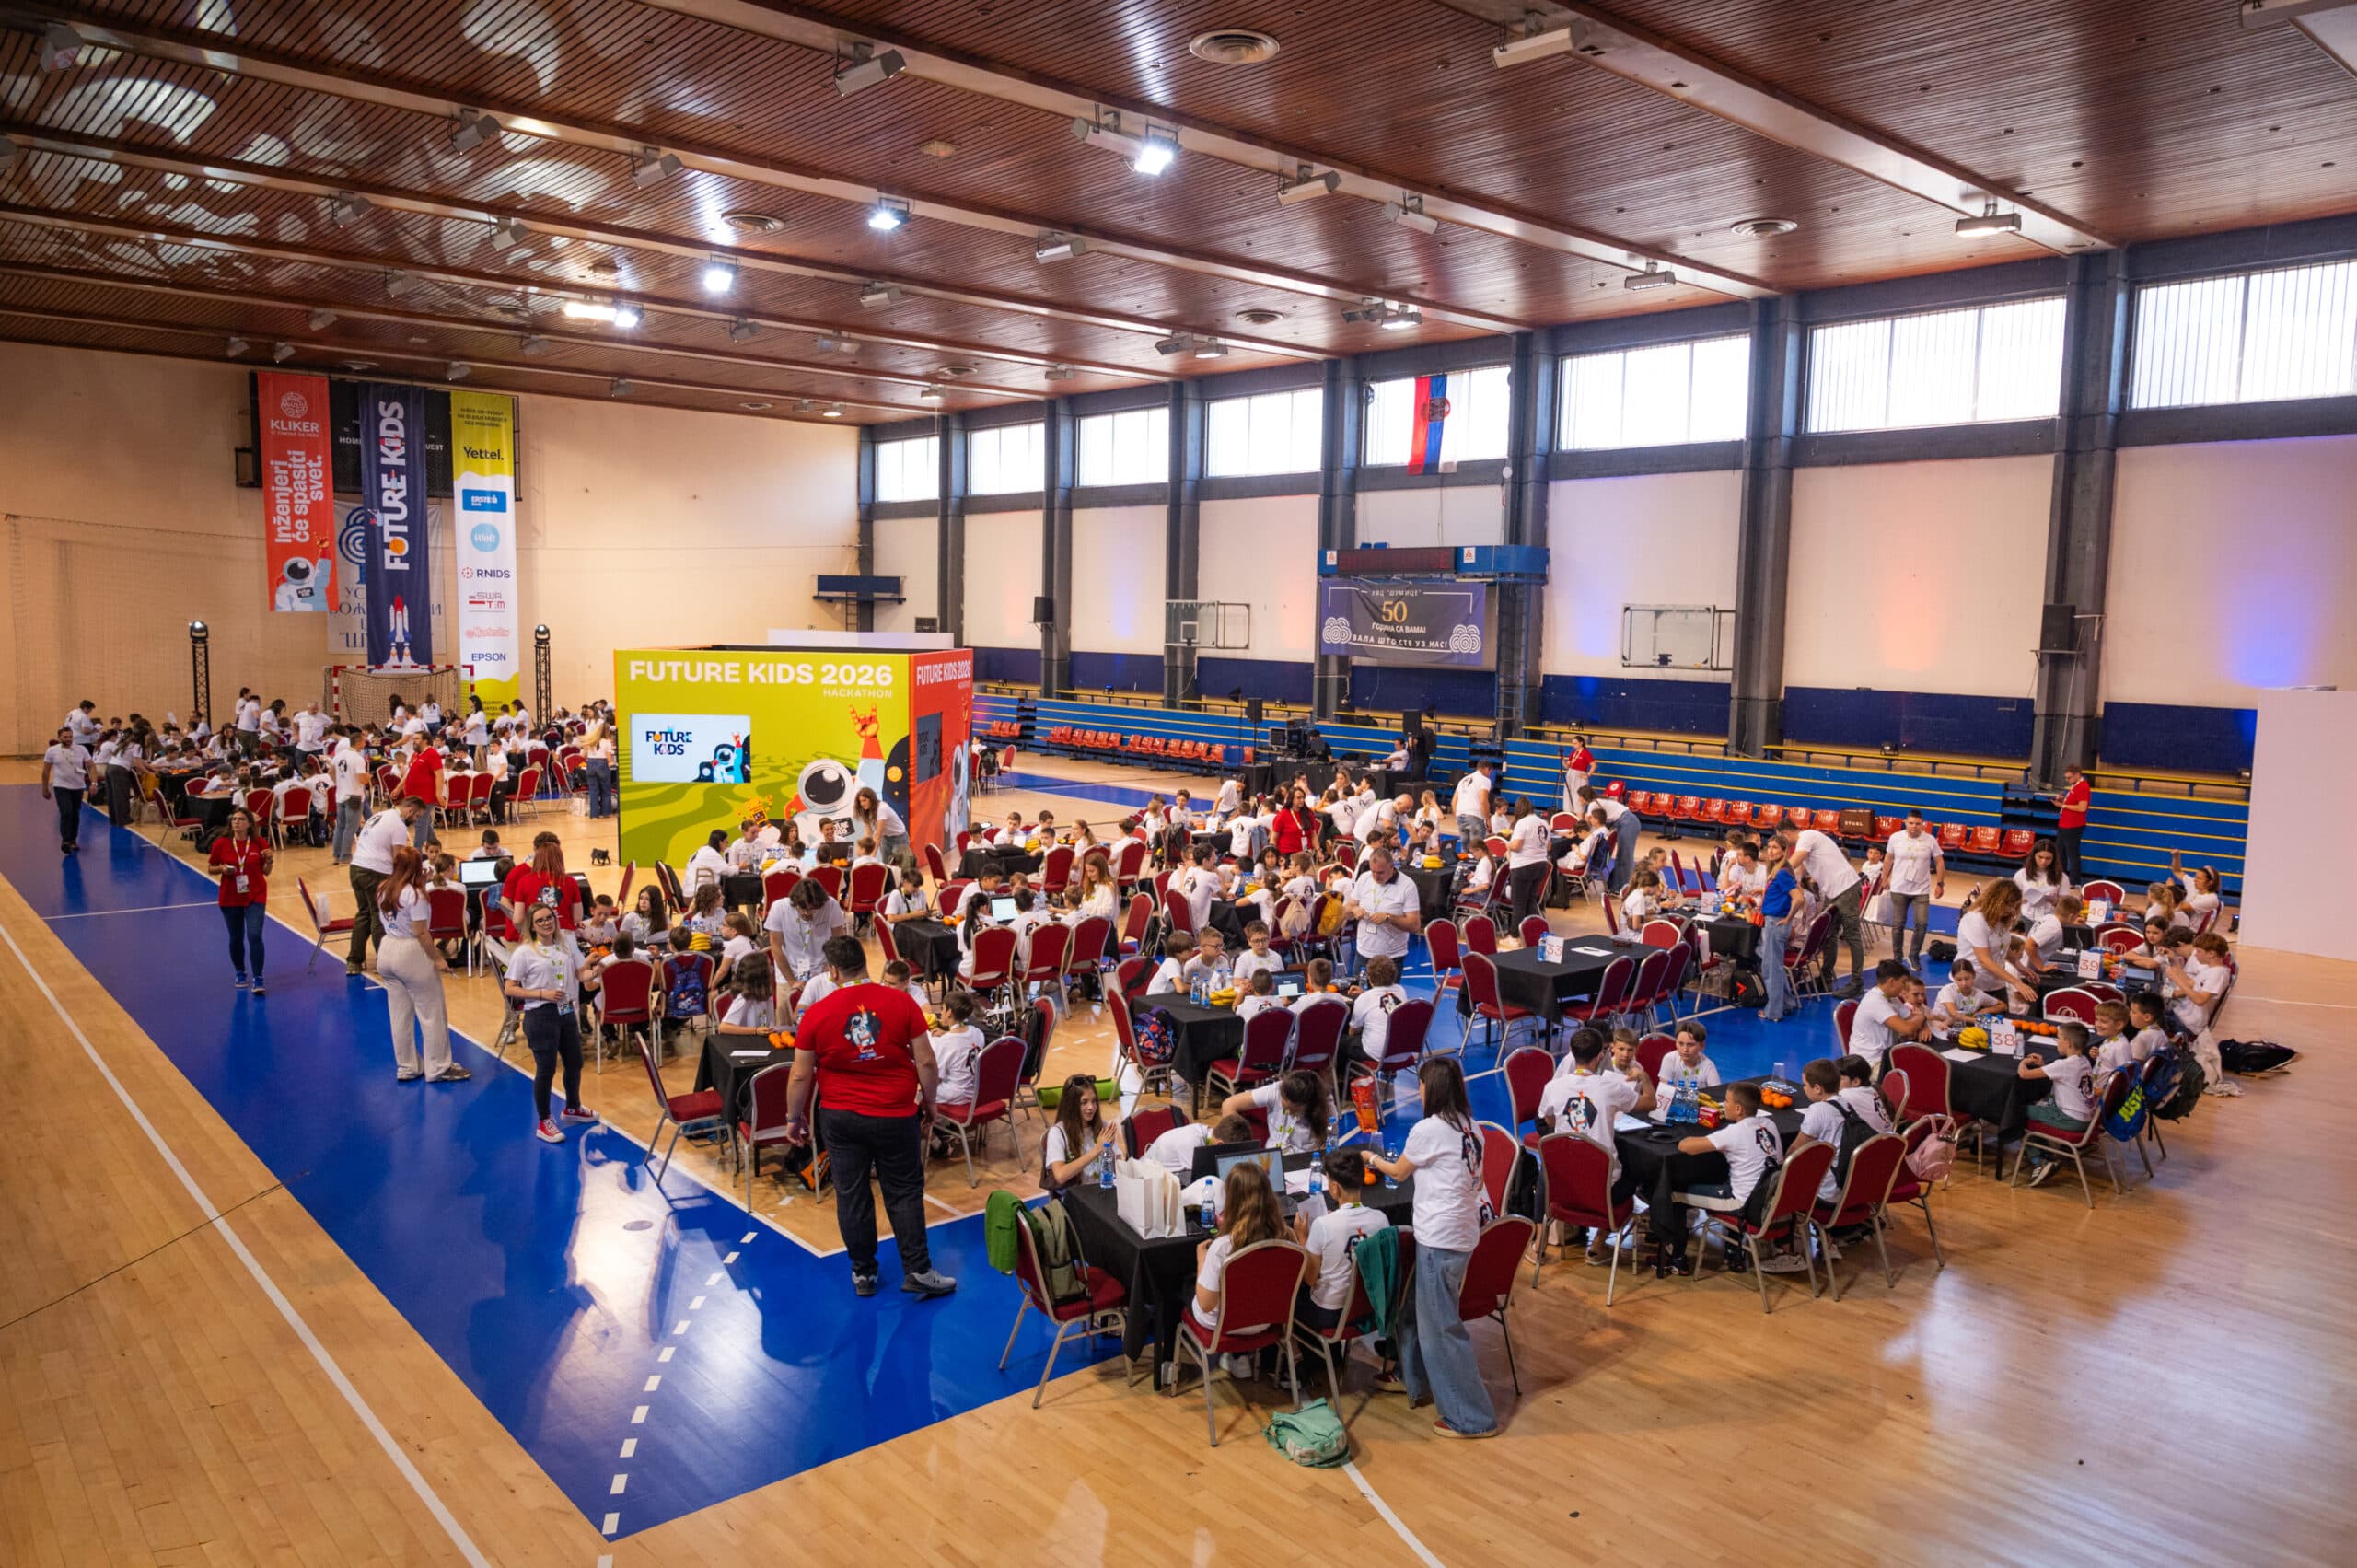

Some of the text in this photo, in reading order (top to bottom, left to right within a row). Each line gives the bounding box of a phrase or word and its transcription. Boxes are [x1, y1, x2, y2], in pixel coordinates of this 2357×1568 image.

[270, 419, 319, 433] KLIKER
[425, 443, 444, 451] UEST
[463, 446, 504, 460] Yettel.
[287, 450, 311, 516] spasiti
[306, 455, 324, 501] svet.
[378, 401, 410, 570] FUTURE KIDS
[270, 459, 293, 543] Inženjeri
[291, 518, 310, 543] će
[477, 569, 511, 579] RNIDS
[1381, 600, 1408, 623] 50
[1371, 622, 1427, 634] ГОДИНА СА ВАМА!
[1377, 636, 1397, 645] ШТО
[1399, 639, 1412, 647] СТЕ
[1415, 640, 1427, 648] УЗ
[1429, 641, 1448, 649] НАС!
[470, 652, 507, 662] EPSON
[630, 661, 893, 686] FUTURE KIDS 2026
[916, 664, 943, 686] FUTURE
[943, 662, 958, 682] KIDS
[958, 660, 972, 679] 2026
[822, 688, 893, 700] HACKATHON
[645, 730, 692, 756] FUTURE KIDS
[2090, 908, 2106, 917] 40
[1547, 944, 1562, 957] 33
[2080, 959, 2099, 972] 39
[1992, 1032, 2014, 1047] 38
[1657, 1093, 1671, 1111] 37
